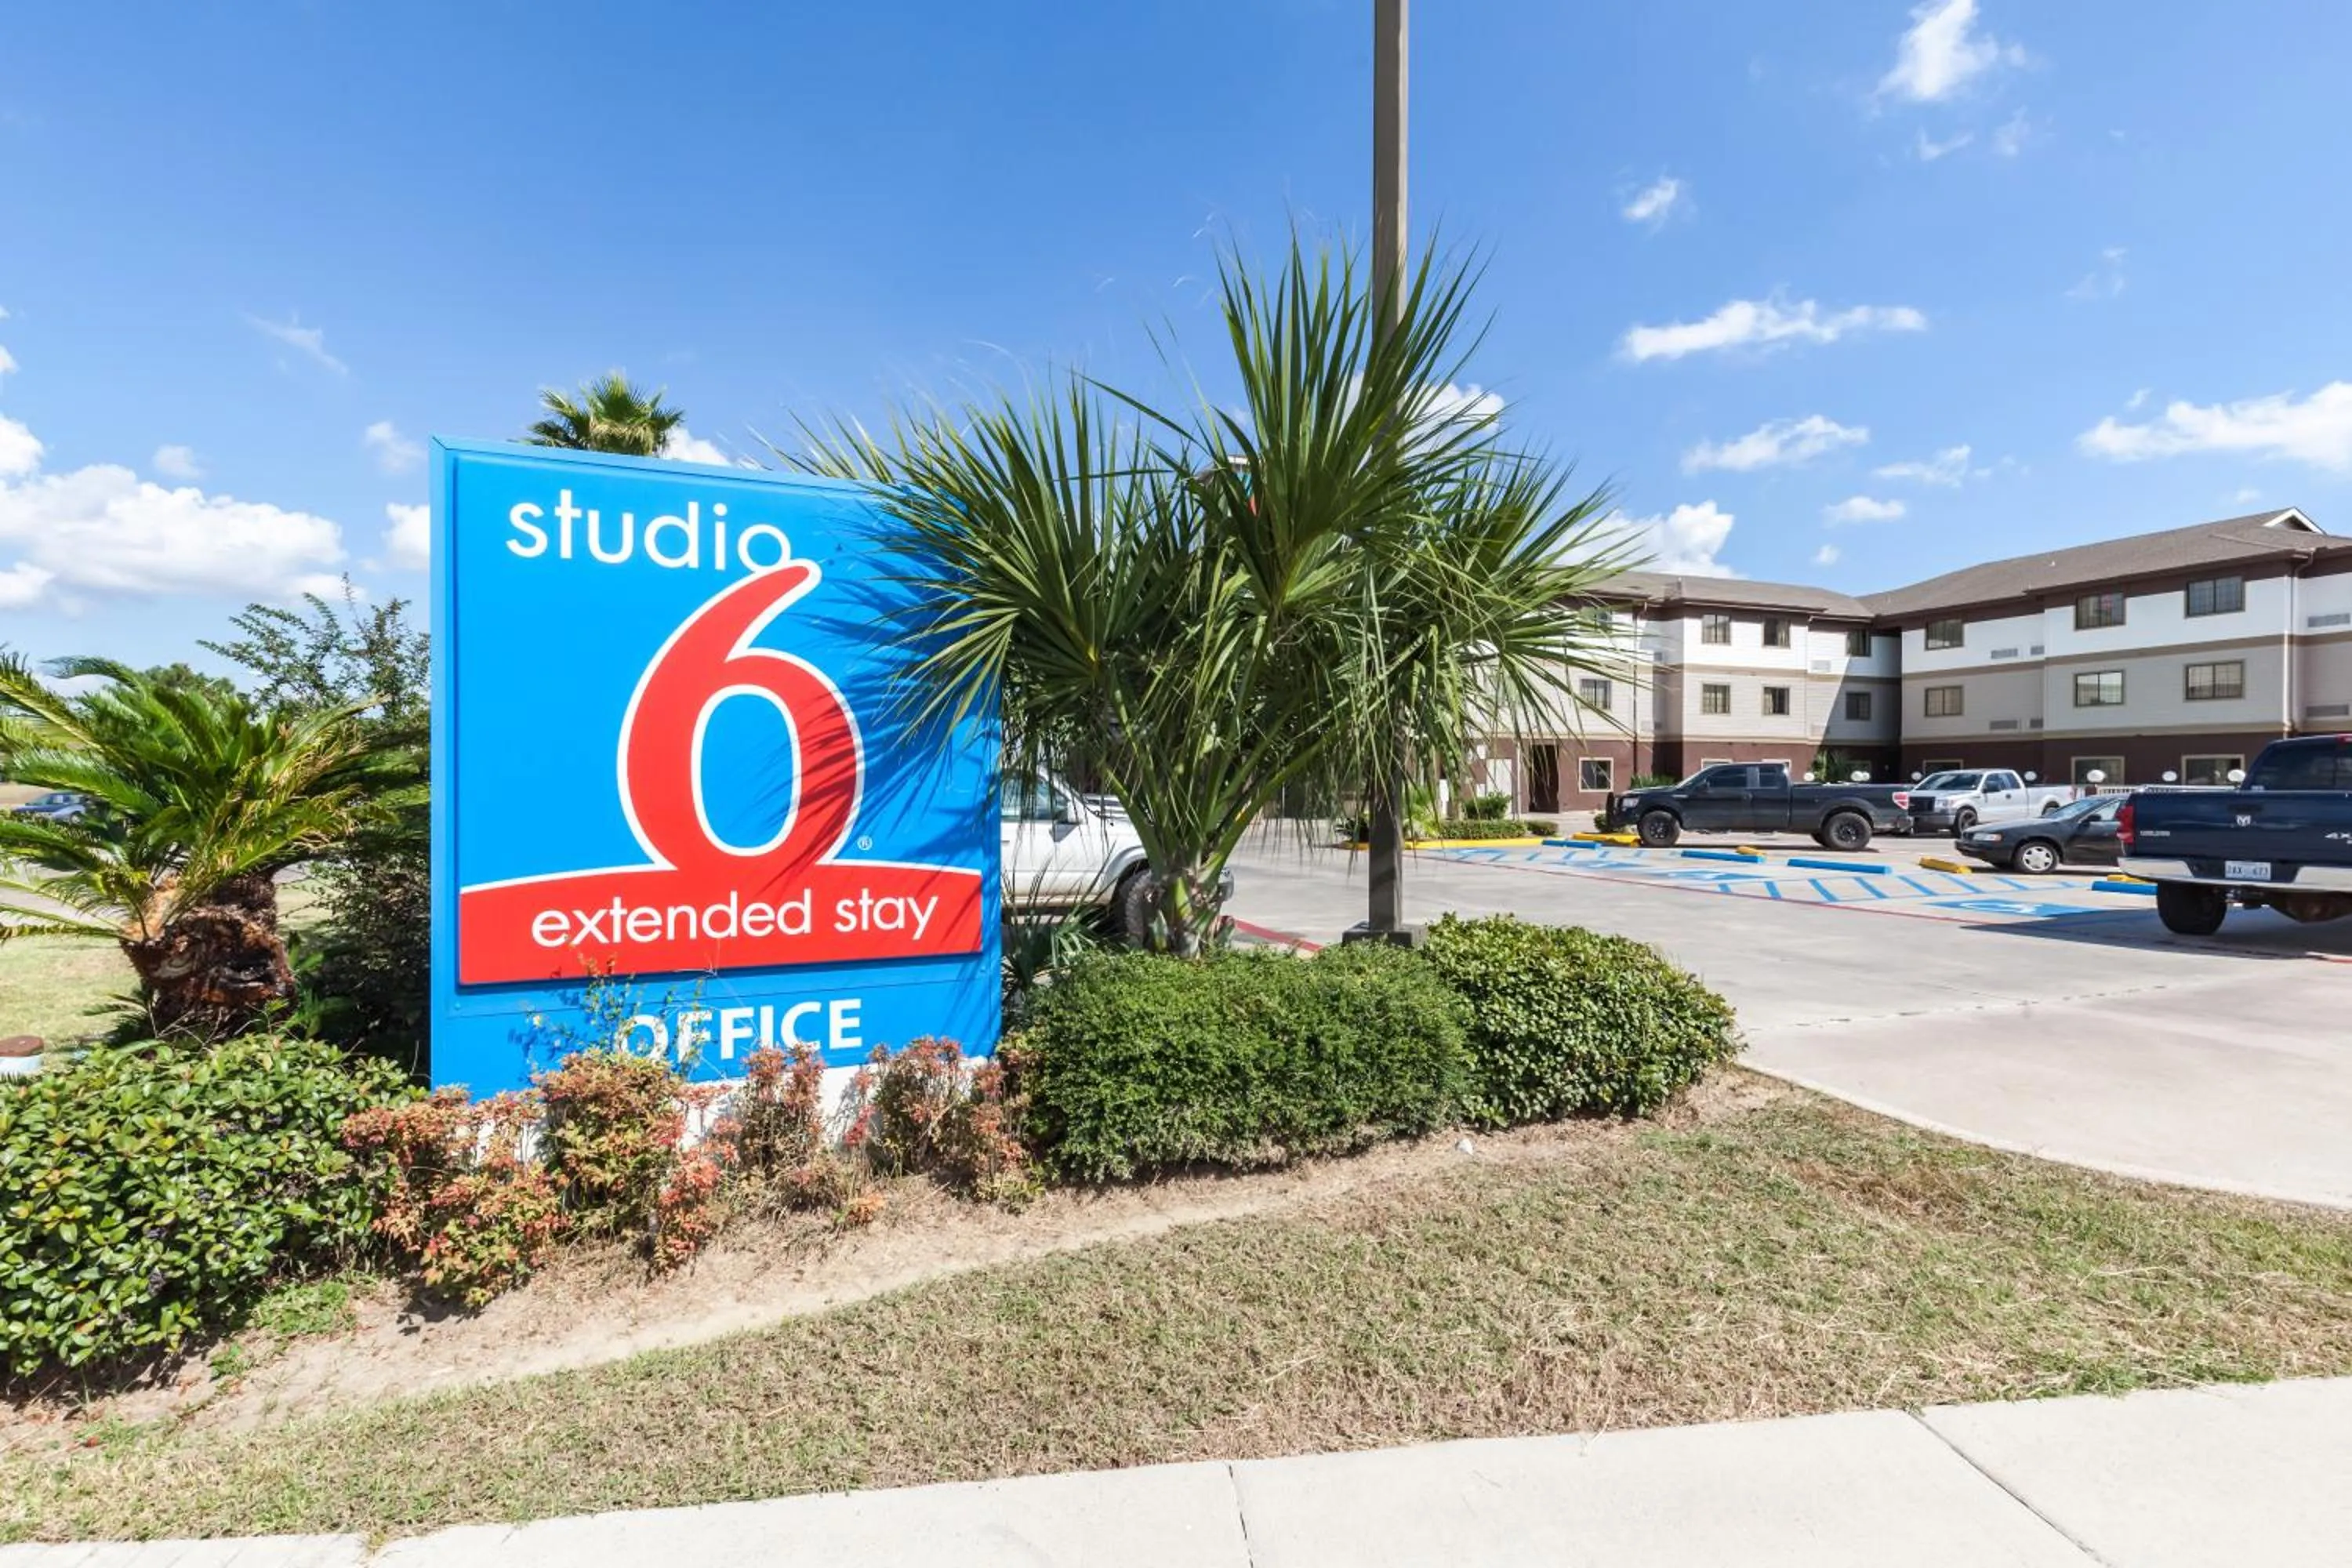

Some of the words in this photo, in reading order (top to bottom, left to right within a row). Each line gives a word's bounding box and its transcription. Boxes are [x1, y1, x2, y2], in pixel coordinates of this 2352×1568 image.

[506, 489, 790, 572] studio
[617, 558, 864, 872] 6
[532, 888, 812, 947] extended
[833, 888, 938, 940] stay
[615, 999, 862, 1062] OFFICE
